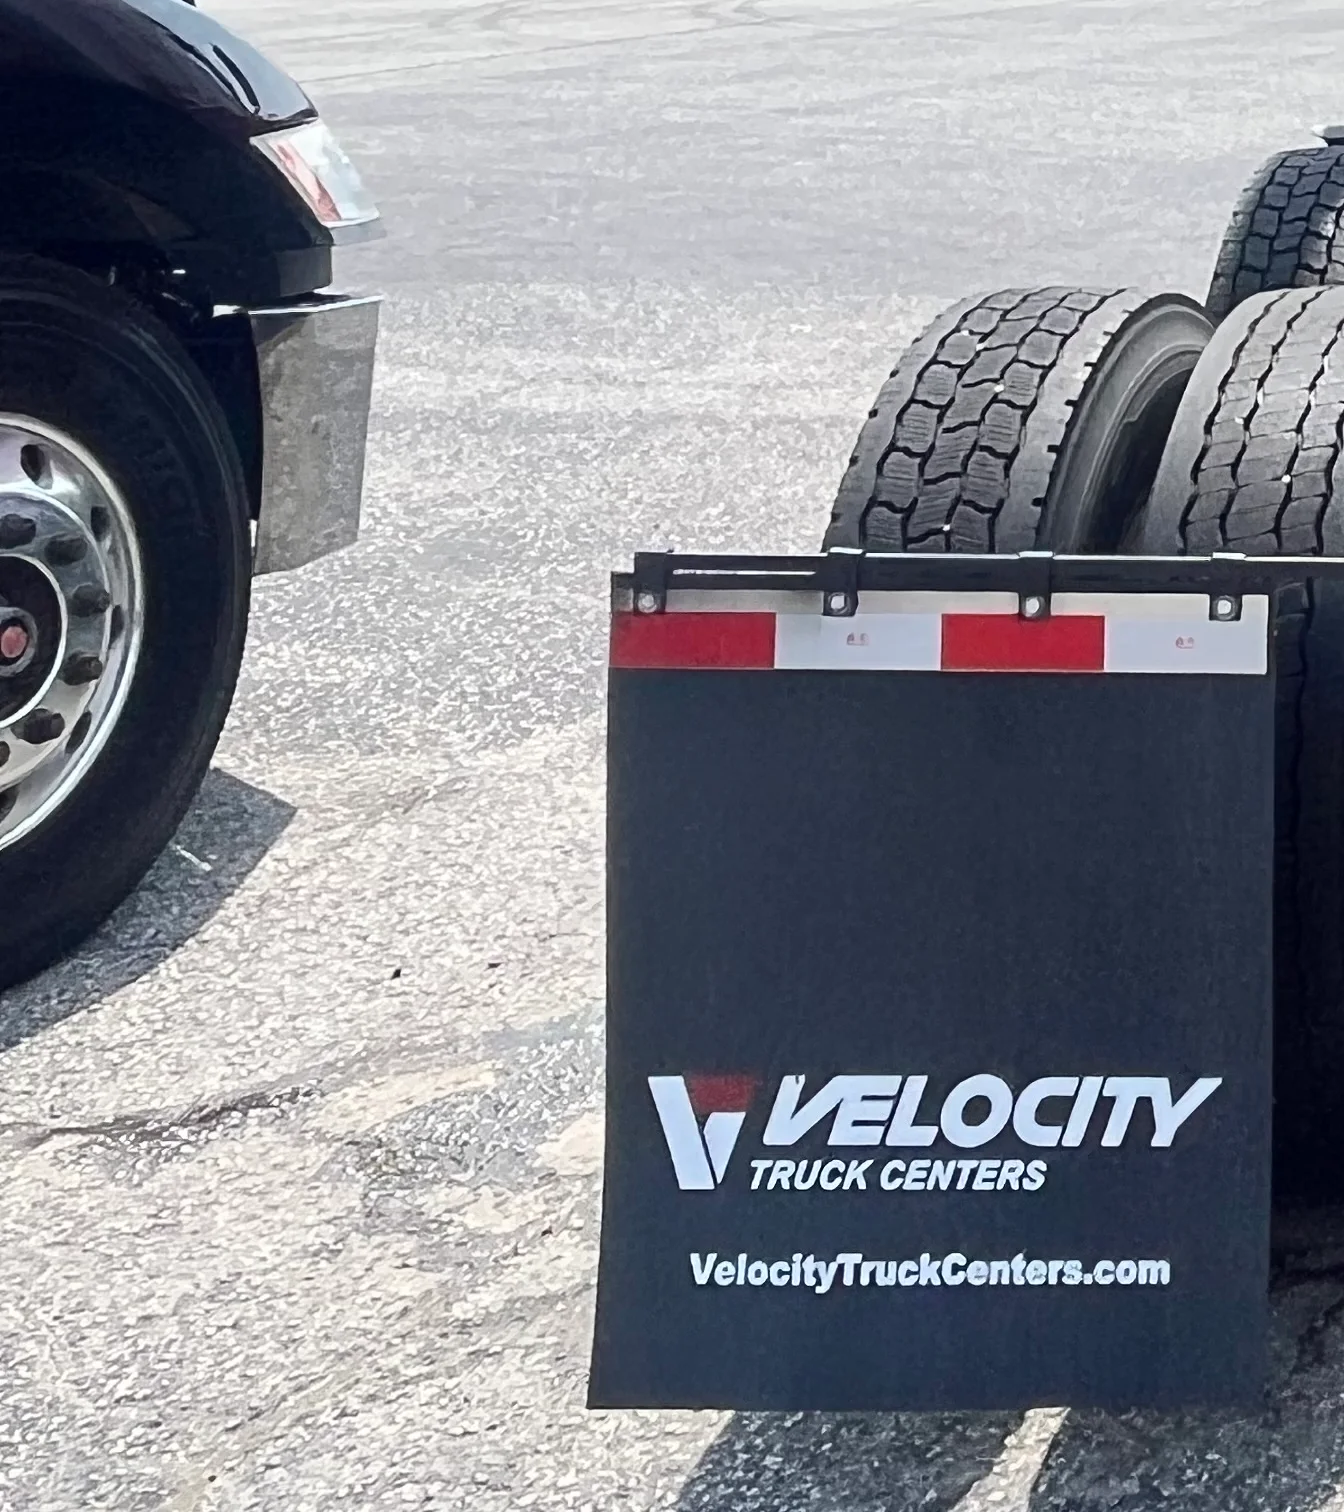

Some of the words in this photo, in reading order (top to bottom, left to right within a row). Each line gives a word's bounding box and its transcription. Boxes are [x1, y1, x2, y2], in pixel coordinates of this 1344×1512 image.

[763, 1073, 1223, 1148] VELOCITY
[750, 1159, 875, 1191] TRUCK
[879, 1159, 1048, 1191] CENTERS
[689, 1252, 1171, 1294] VelocityTruckCenters.com
